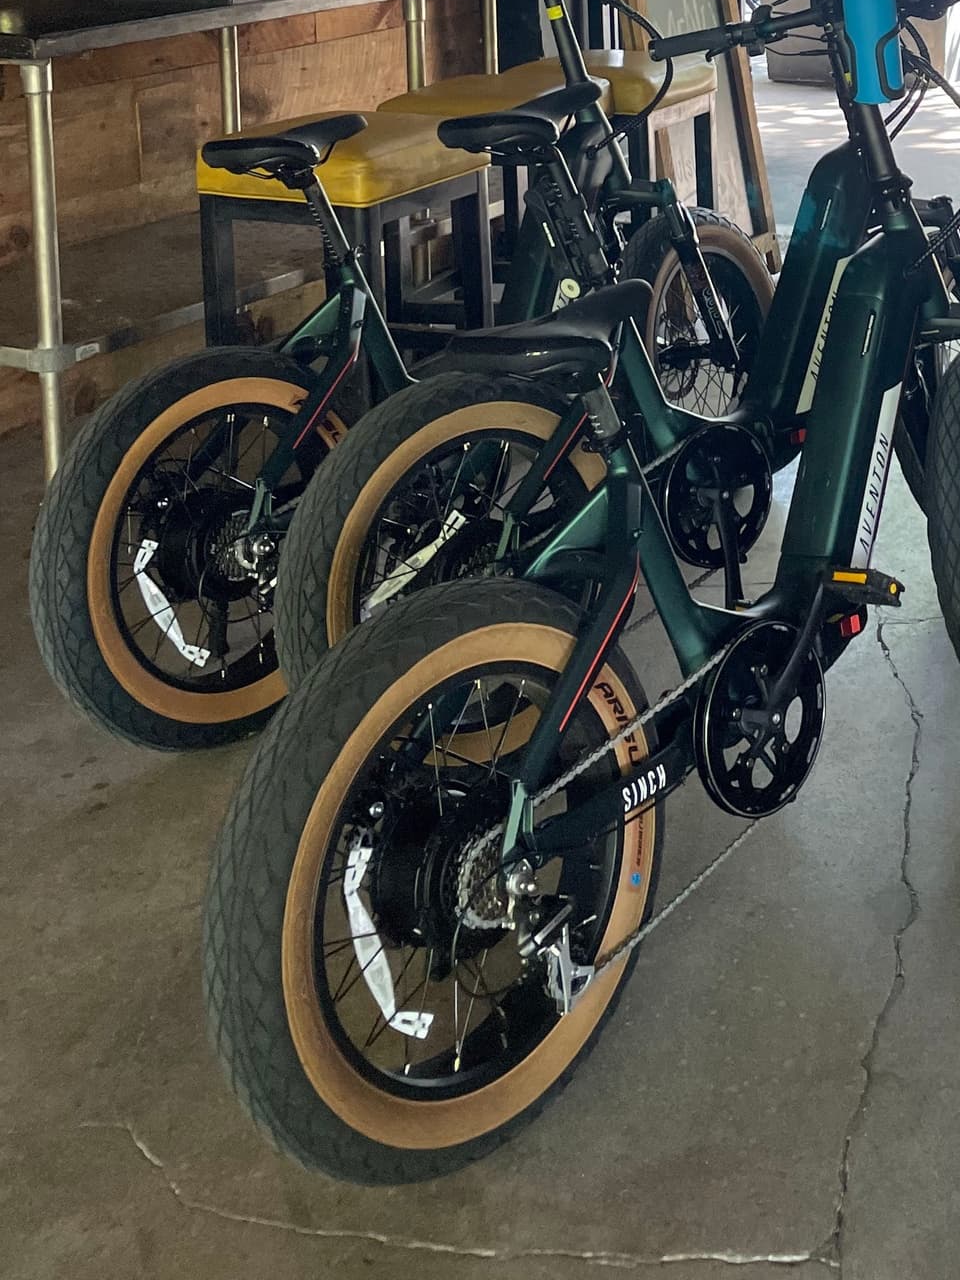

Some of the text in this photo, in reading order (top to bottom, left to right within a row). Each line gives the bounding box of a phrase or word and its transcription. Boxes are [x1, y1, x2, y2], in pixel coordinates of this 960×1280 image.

[861, 432, 889, 555] AVENTON
[595, 682, 641, 767] ARISU
[622, 764, 667, 812] SINCH
